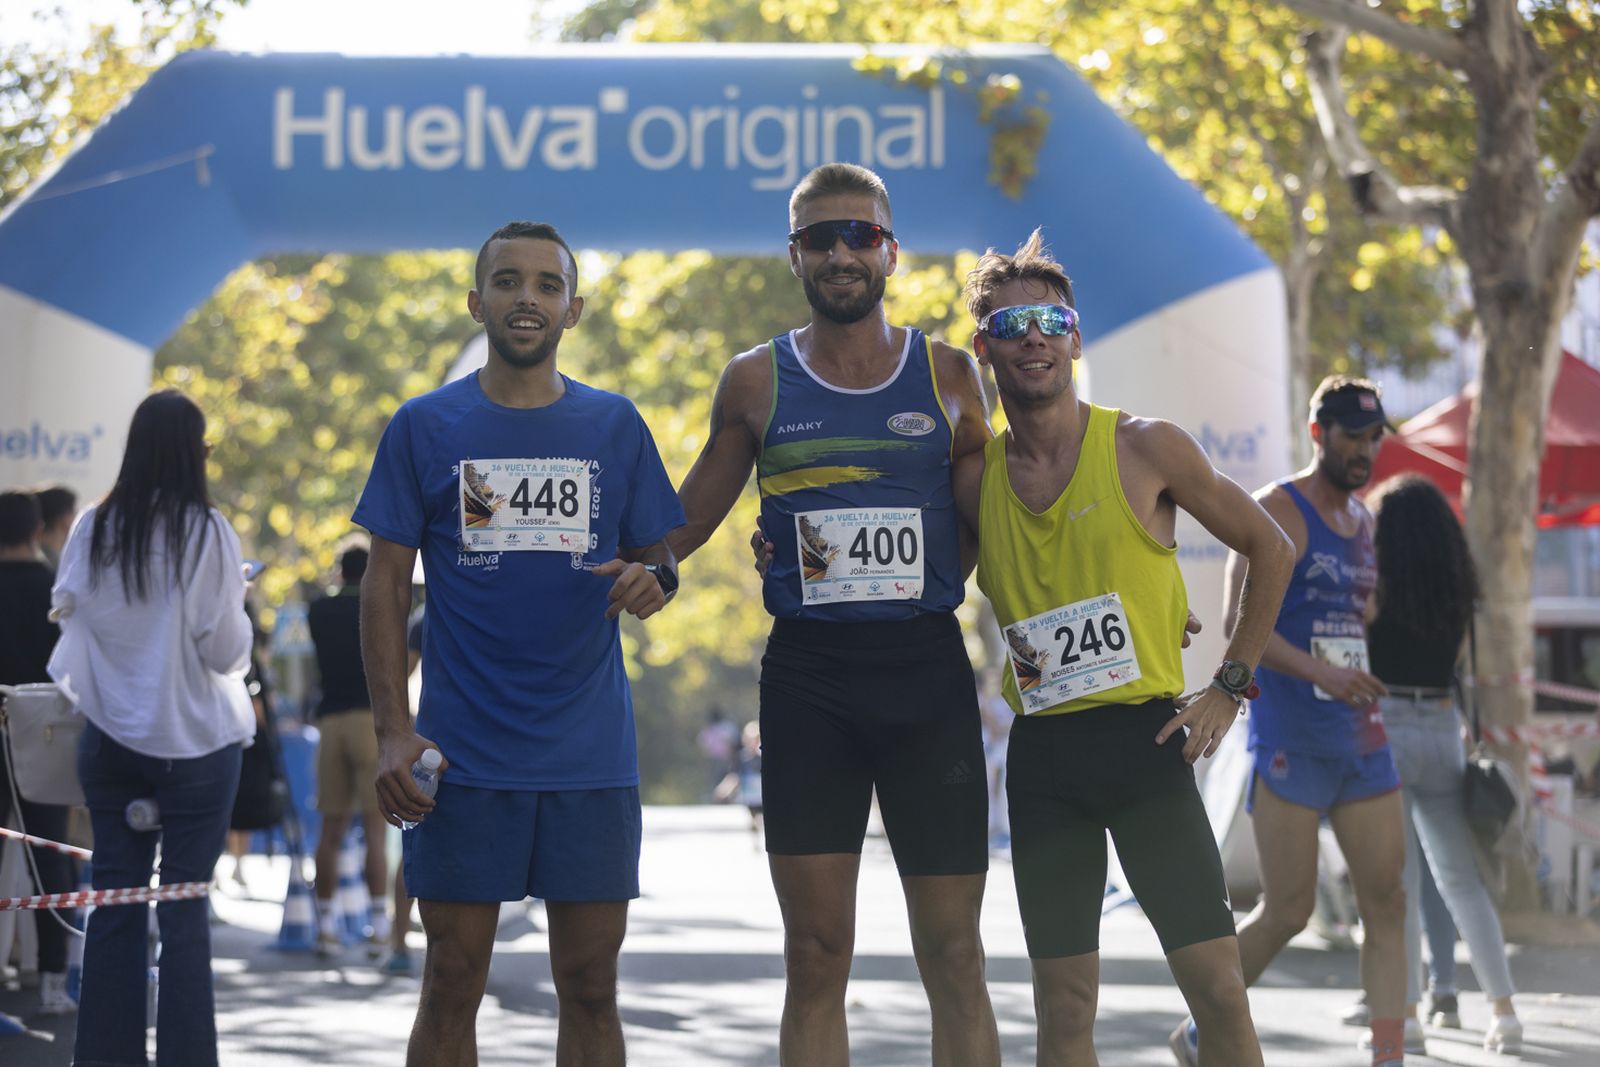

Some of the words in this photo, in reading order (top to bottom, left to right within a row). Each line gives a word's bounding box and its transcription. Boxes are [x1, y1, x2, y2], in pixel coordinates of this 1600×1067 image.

[274, 85, 596, 170] Huelva
[628, 84, 946, 191] original
[777, 421, 824, 434] ANAKY
[0, 420, 92, 461] elva
[491, 464, 501, 472] 36
[504, 464, 537, 472] VUELTA
[540, 464, 548, 472] A
[550, 464, 584, 474] HUELVA
[509, 478, 579, 518] 448
[591, 487, 601, 519] 2023
[515, 518, 547, 526] YOUSSEF
[824, 515, 834, 523] 36
[837, 513, 870, 522] VUELTA
[873, 513, 880, 521] A
[882, 512, 914, 521] HUELVA
[848, 526, 918, 566] 400
[457, 553, 499, 567] Huelva
[850, 567, 869, 576] JOÃO
[1028, 622, 1038, 631] 36
[1040, 610, 1069, 627] VUELTA
[1072, 608, 1078, 616] A
[1080, 599, 1115, 613] HUELVA
[1054, 613, 1126, 666] 246
[1050, 666, 1076, 679] MOISES
